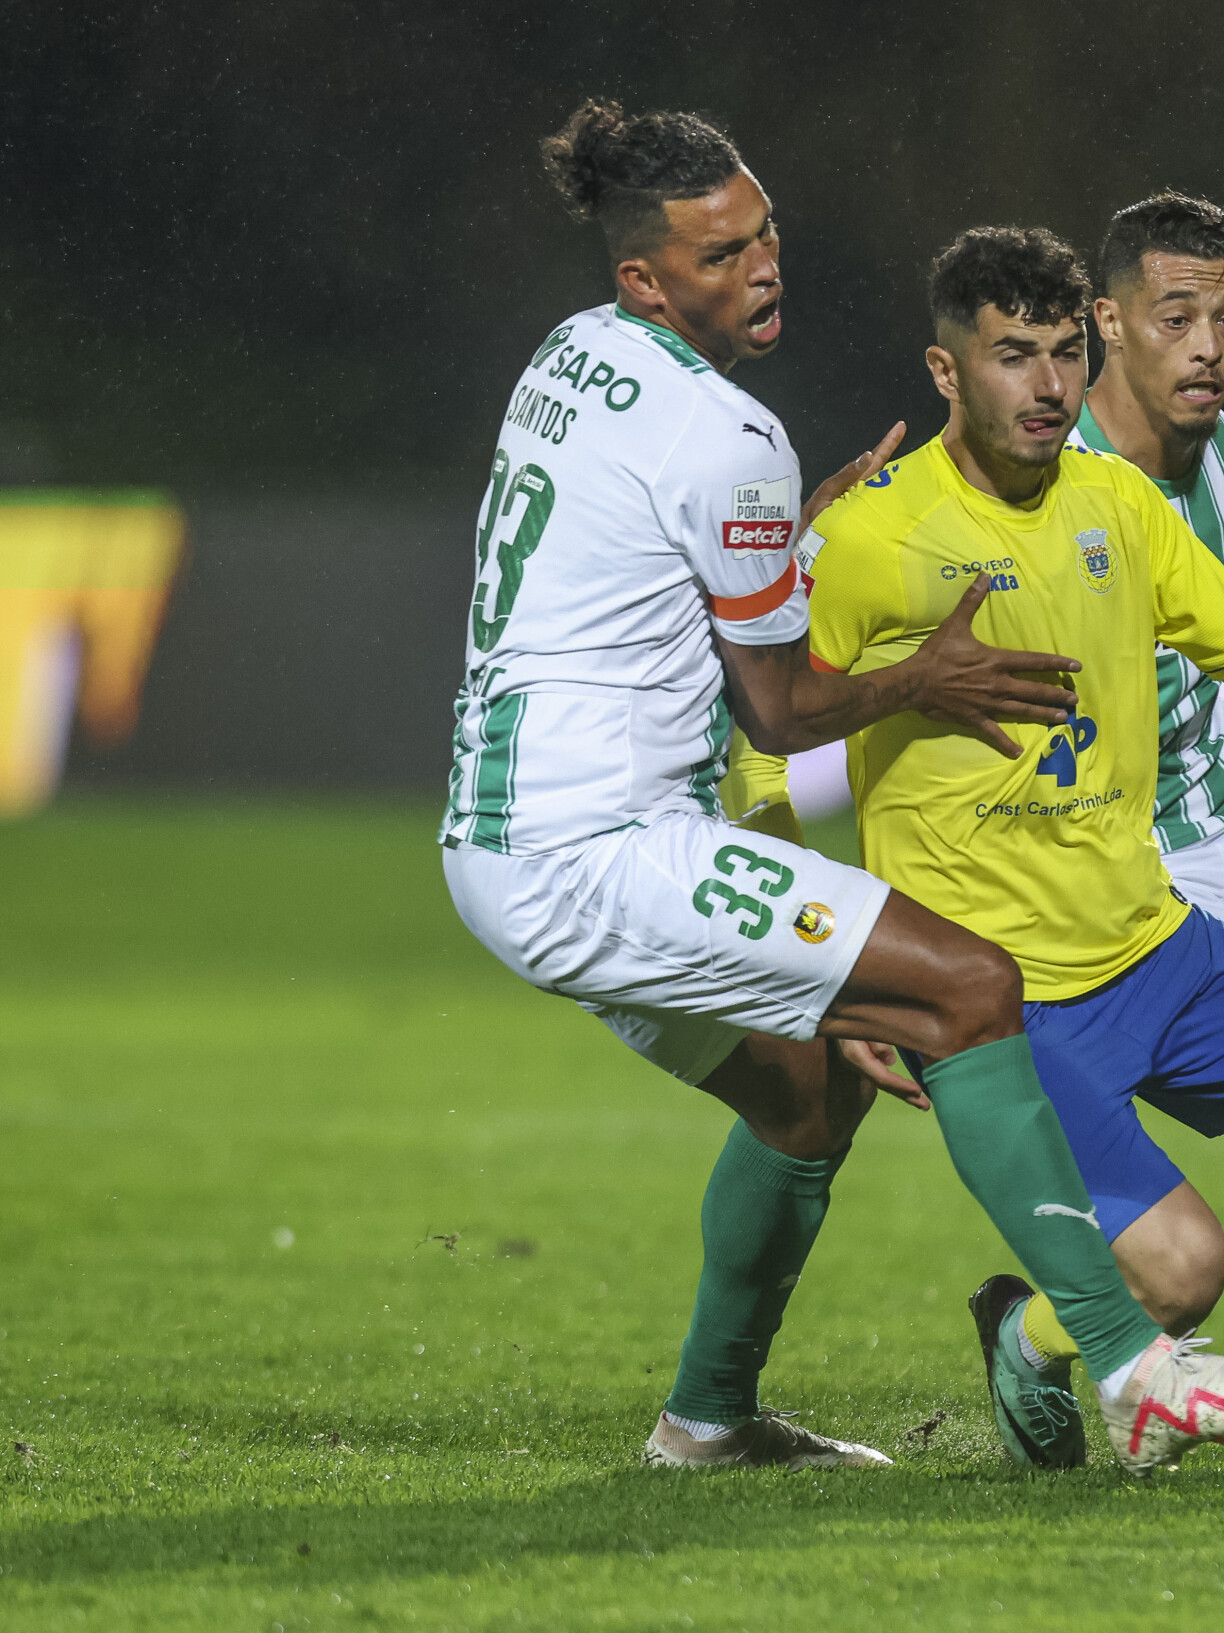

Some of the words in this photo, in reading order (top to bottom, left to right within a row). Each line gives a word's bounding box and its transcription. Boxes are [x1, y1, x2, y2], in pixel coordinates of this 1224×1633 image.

[548, 344, 641, 412] SAPO
[507, 384, 577, 445] SANTOS
[737, 489, 761, 504] LIGA
[737, 505, 786, 520] PORTUGAL
[1027, 801, 1074, 817] Carlos
[1072, 793, 1101, 813] Pinh
[1103, 787, 1125, 805] Lda.
[692, 844, 795, 941] 33
